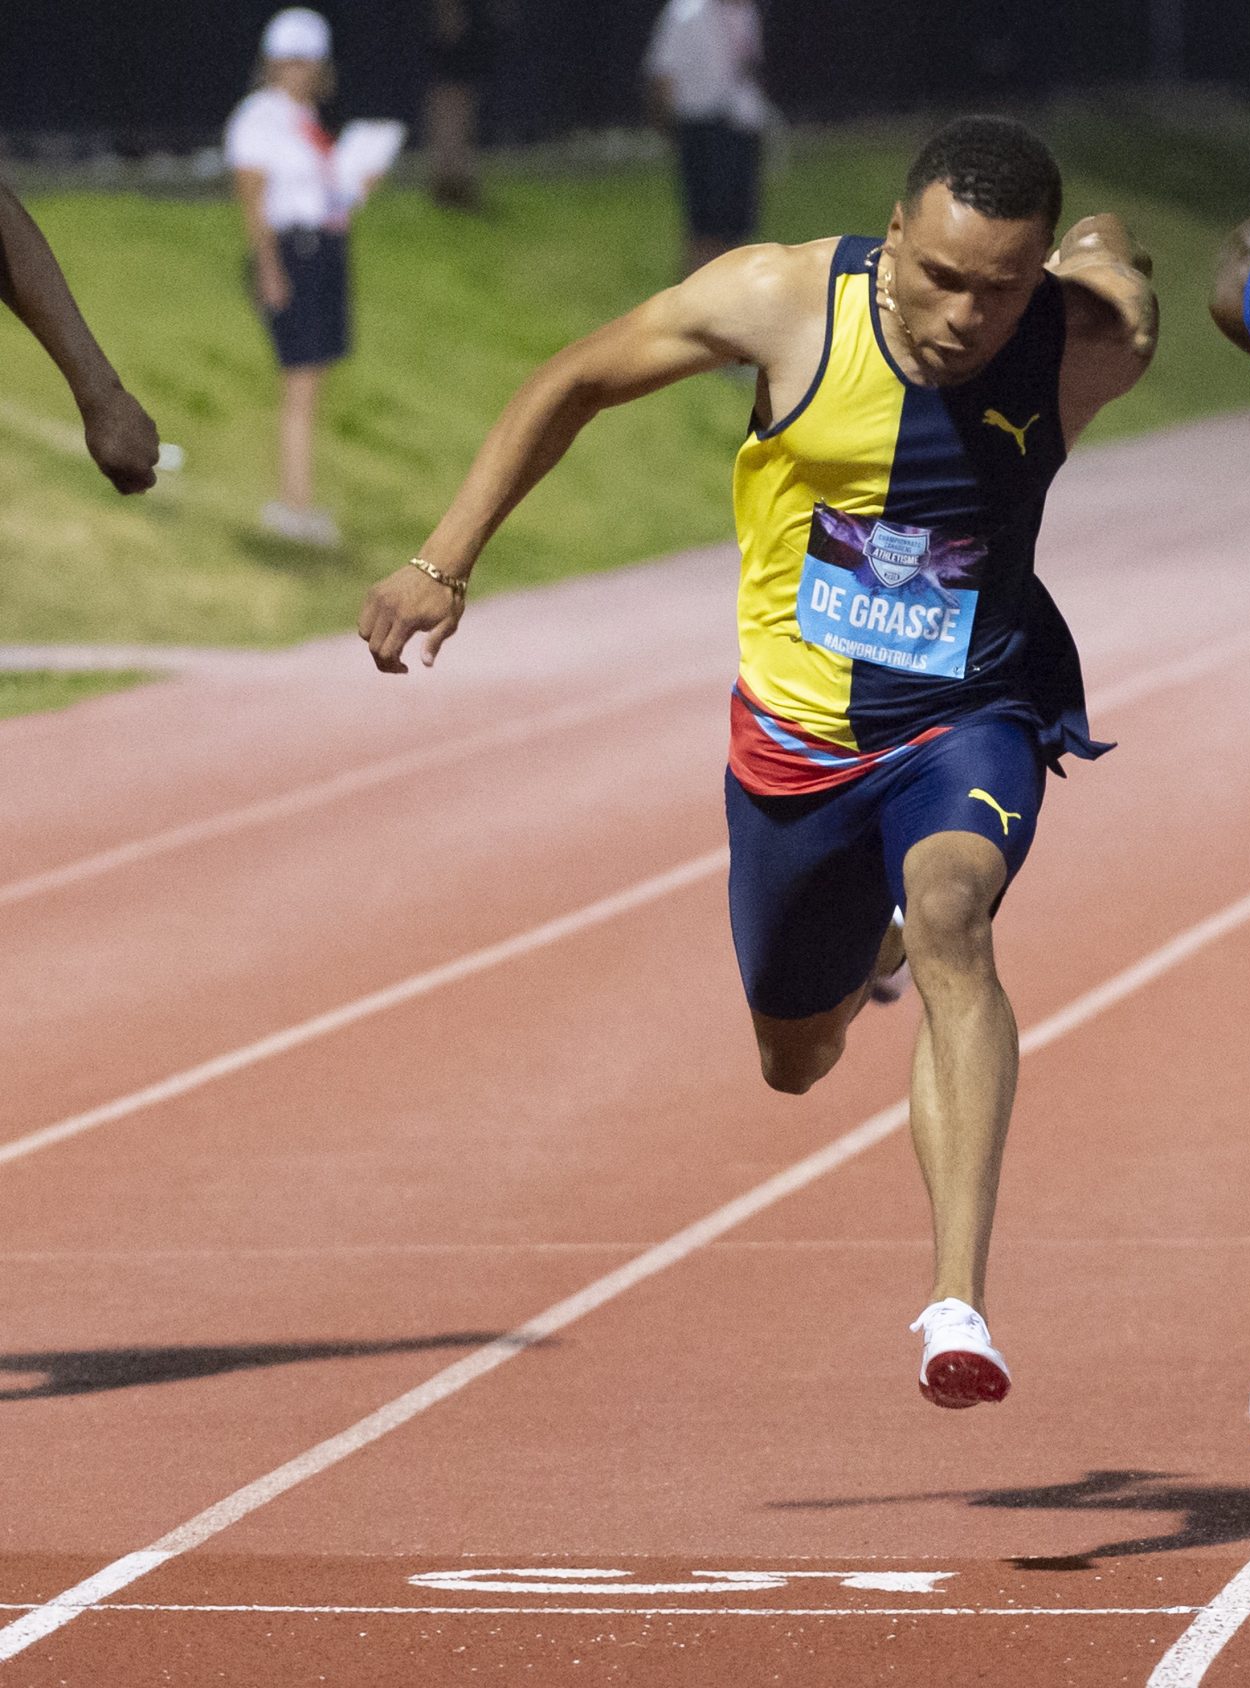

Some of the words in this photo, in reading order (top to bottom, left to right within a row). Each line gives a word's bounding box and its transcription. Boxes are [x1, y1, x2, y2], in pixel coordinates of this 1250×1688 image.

[872, 548, 920, 565] ATHLETISME
[810, 578, 847, 622] DE
[849, 594, 961, 643] GRASSE
[823, 632, 929, 670] #ACWORLDTRIALS
